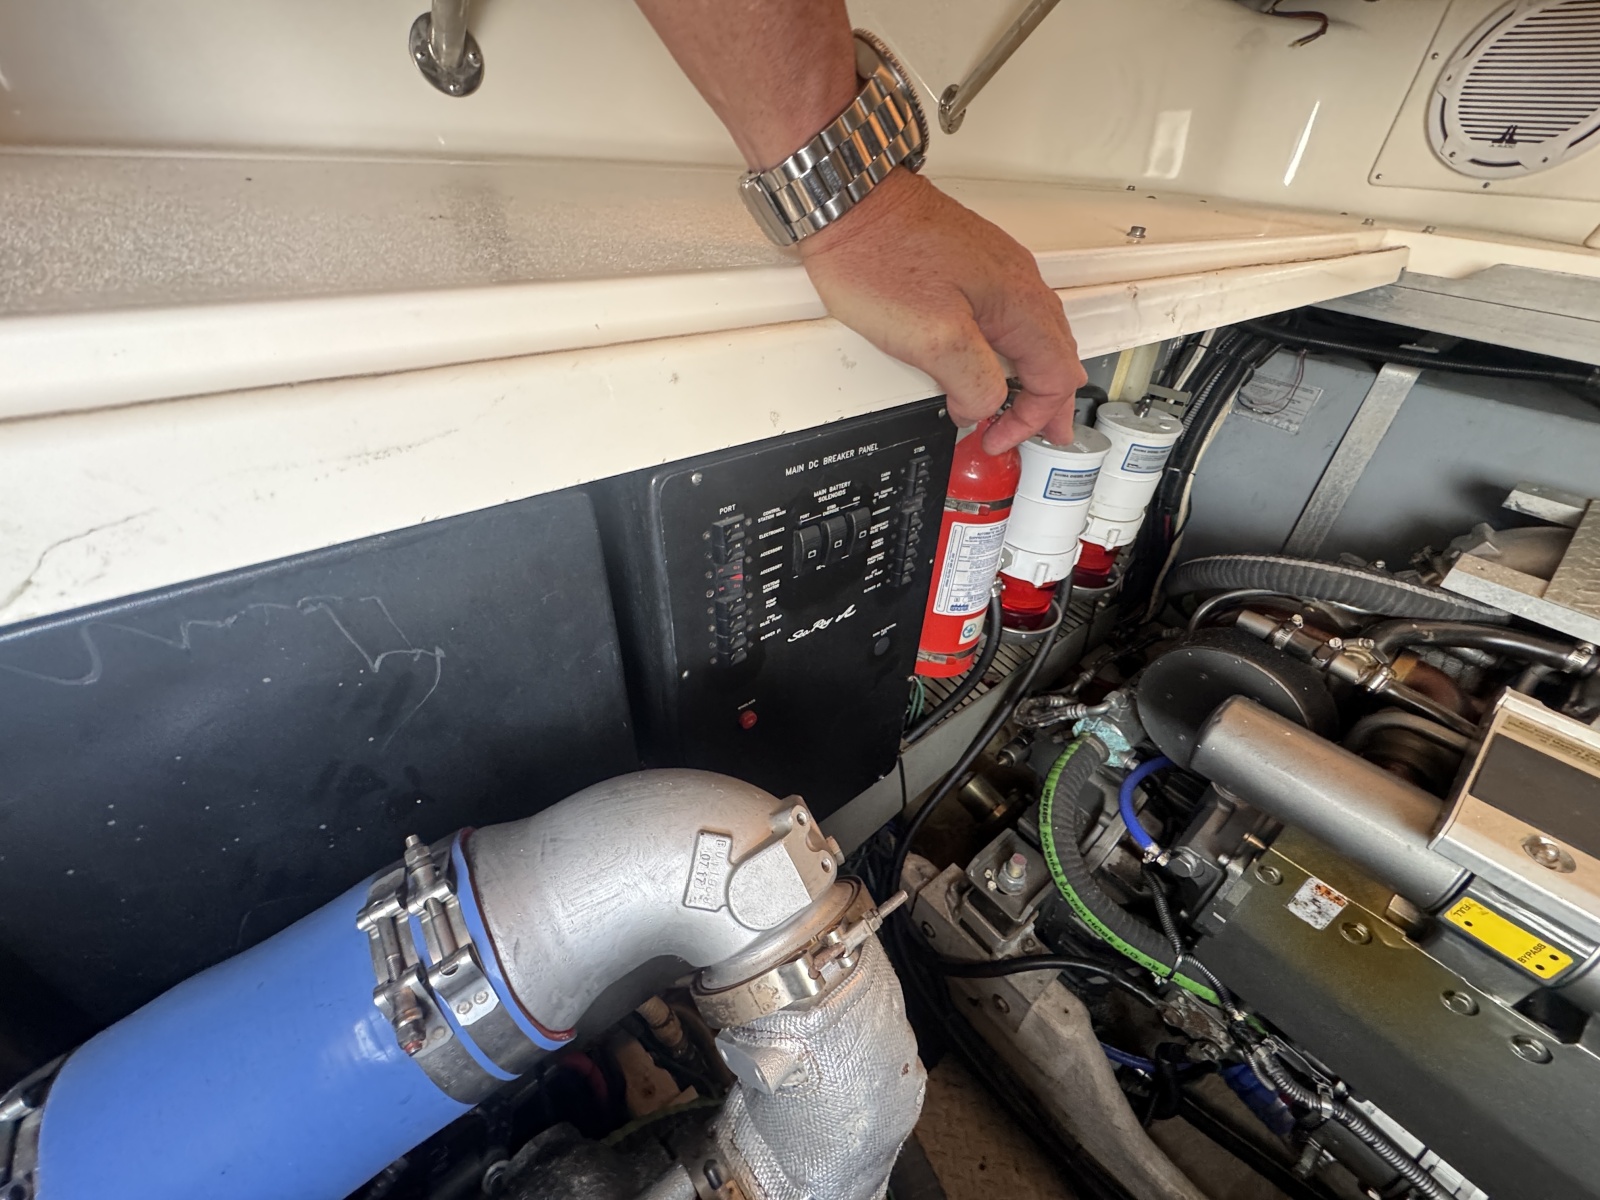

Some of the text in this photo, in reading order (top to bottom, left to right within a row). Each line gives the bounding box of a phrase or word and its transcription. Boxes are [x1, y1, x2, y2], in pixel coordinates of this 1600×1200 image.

[785, 443, 879, 476] MAIN DC BREAKER PANEL
[814, 481, 851, 498] MAIN BATTERY
[818, 489, 846, 503] SOLENOIDS
[719, 504, 736, 515] PORT
[759, 526, 785, 540] ELECTRONICS
[1042, 831, 1062, 877] MARINE
[1060, 880, 1087, 917] WATER
[1453, 903, 1472, 918] FULL
[1516, 942, 1548, 964] BYPASS
